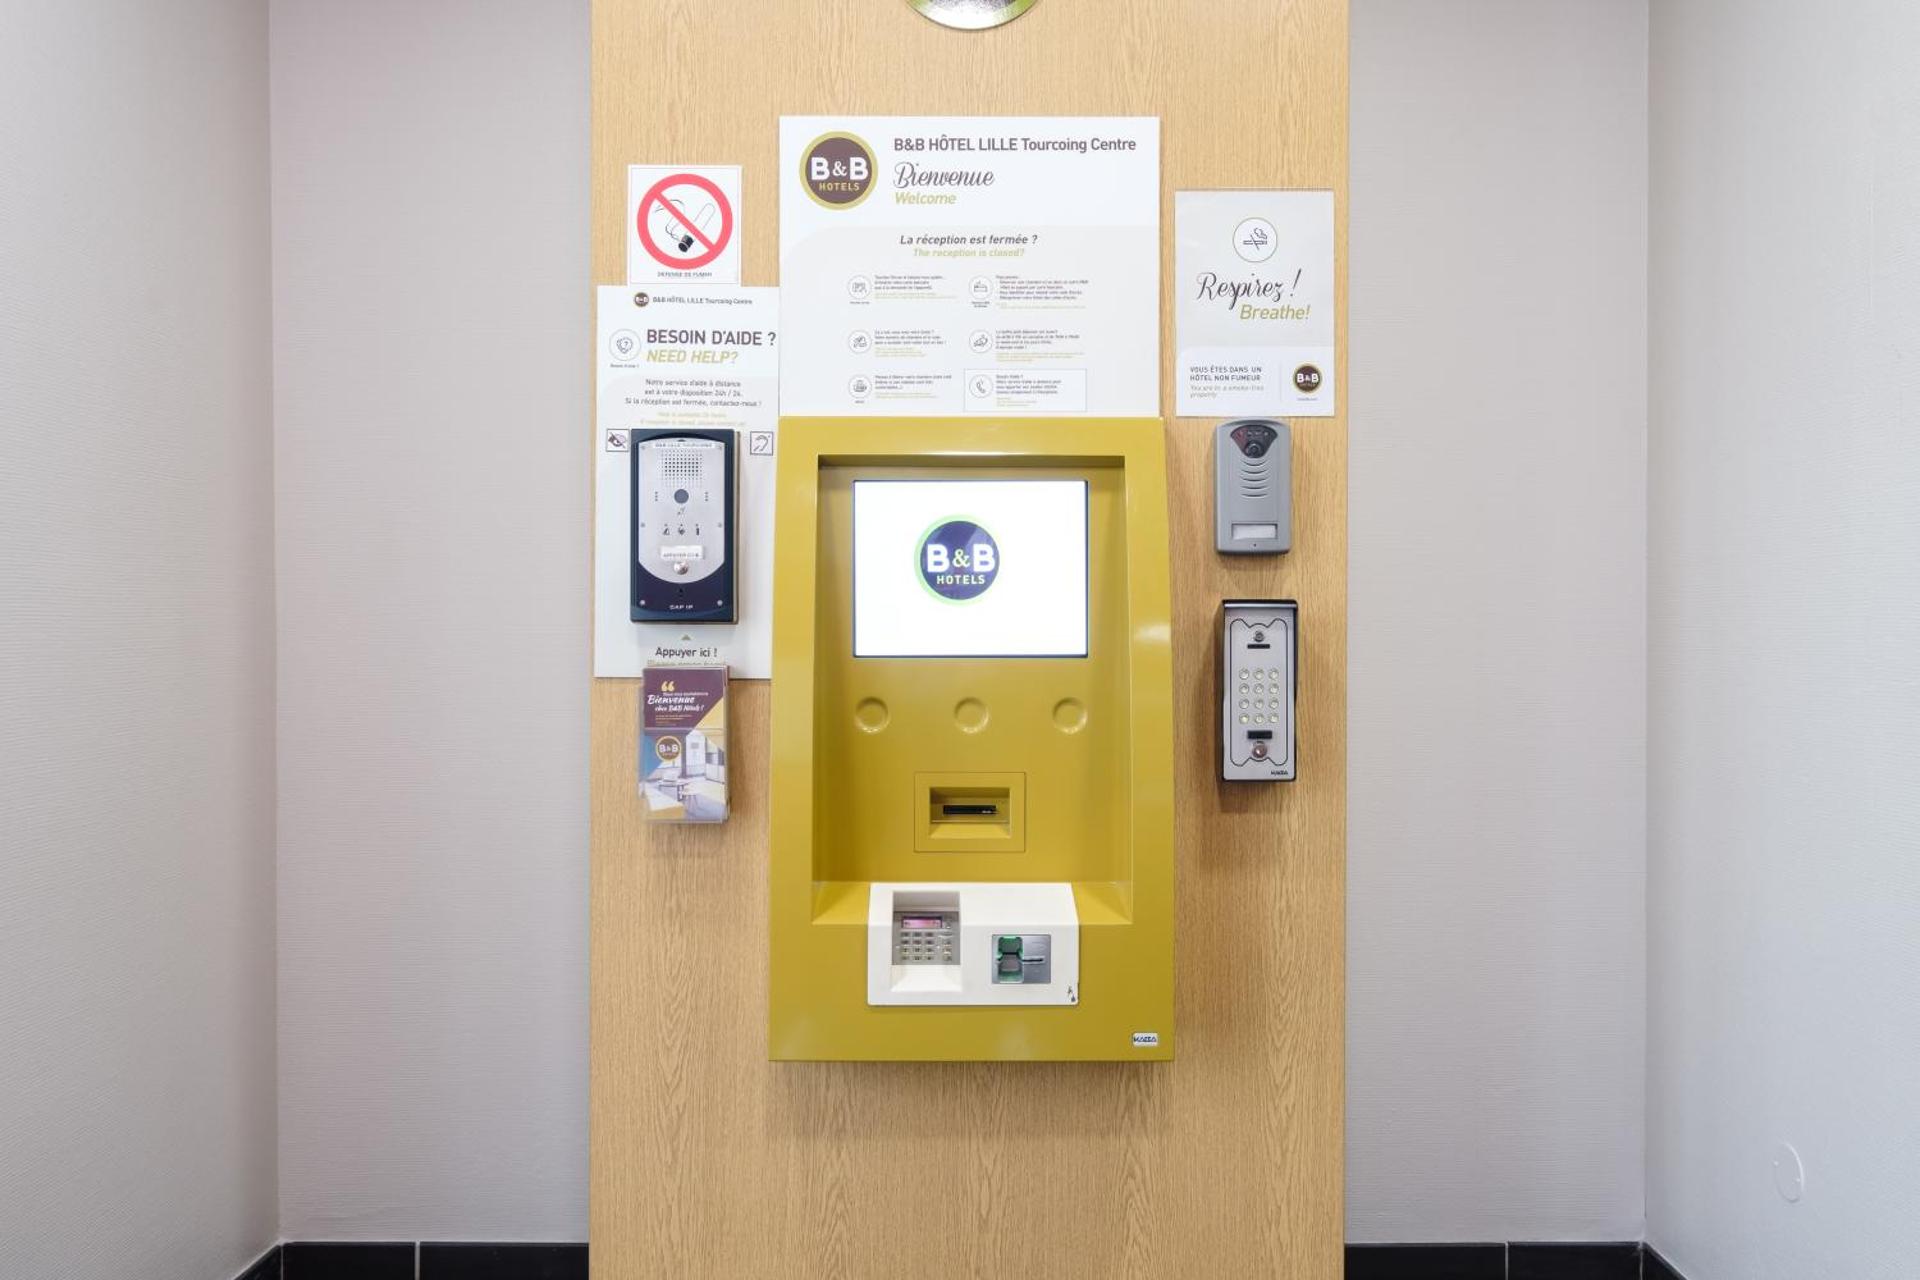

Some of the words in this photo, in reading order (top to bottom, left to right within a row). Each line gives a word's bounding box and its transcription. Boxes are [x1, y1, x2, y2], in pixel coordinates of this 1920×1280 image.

[894, 138, 925, 151] B&B
[929, 134, 975, 151] HÔTEL
[979, 138, 1018, 151] LILLE
[1021, 138, 1087, 154] Tourcoing
[1091, 138, 1136, 151] Centre
[811, 157, 869, 181] B&B
[893, 161, 994, 189] Bienvenue
[819, 182, 860, 191] HOTELS
[895, 192, 956, 205] Welcome
[900, 235, 913, 245] La
[916, 234, 966, 247] réception
[970, 235, 986, 245] est
[989, 234, 1028, 245] fermée
[1032, 235, 1038, 245] ?
[913, 248, 929, 257] The
[932, 248, 976, 259] reception
[1196, 272, 1284, 310] Respirez
[1290, 268, 1302, 297] !
[1240, 304, 1311, 320] Breathe!
[647, 329, 706, 344] BESOIN
[712, 331, 762, 346] D'AIDE
[768, 332, 776, 346] ?
[647, 350, 687, 363] NEED
[691, 351, 738, 364] HELP?
[1210, 364, 1228, 373] ÊTES
[1190, 373, 1213, 381] HÔTEL
[927, 543, 996, 573] B&B
[936, 574, 986, 585] HOTELS
[655, 647, 696, 659] Appuyer
[700, 648, 711, 657] ici
[714, 648, 718, 657] !
[647, 694, 695, 705] Bienvenue
